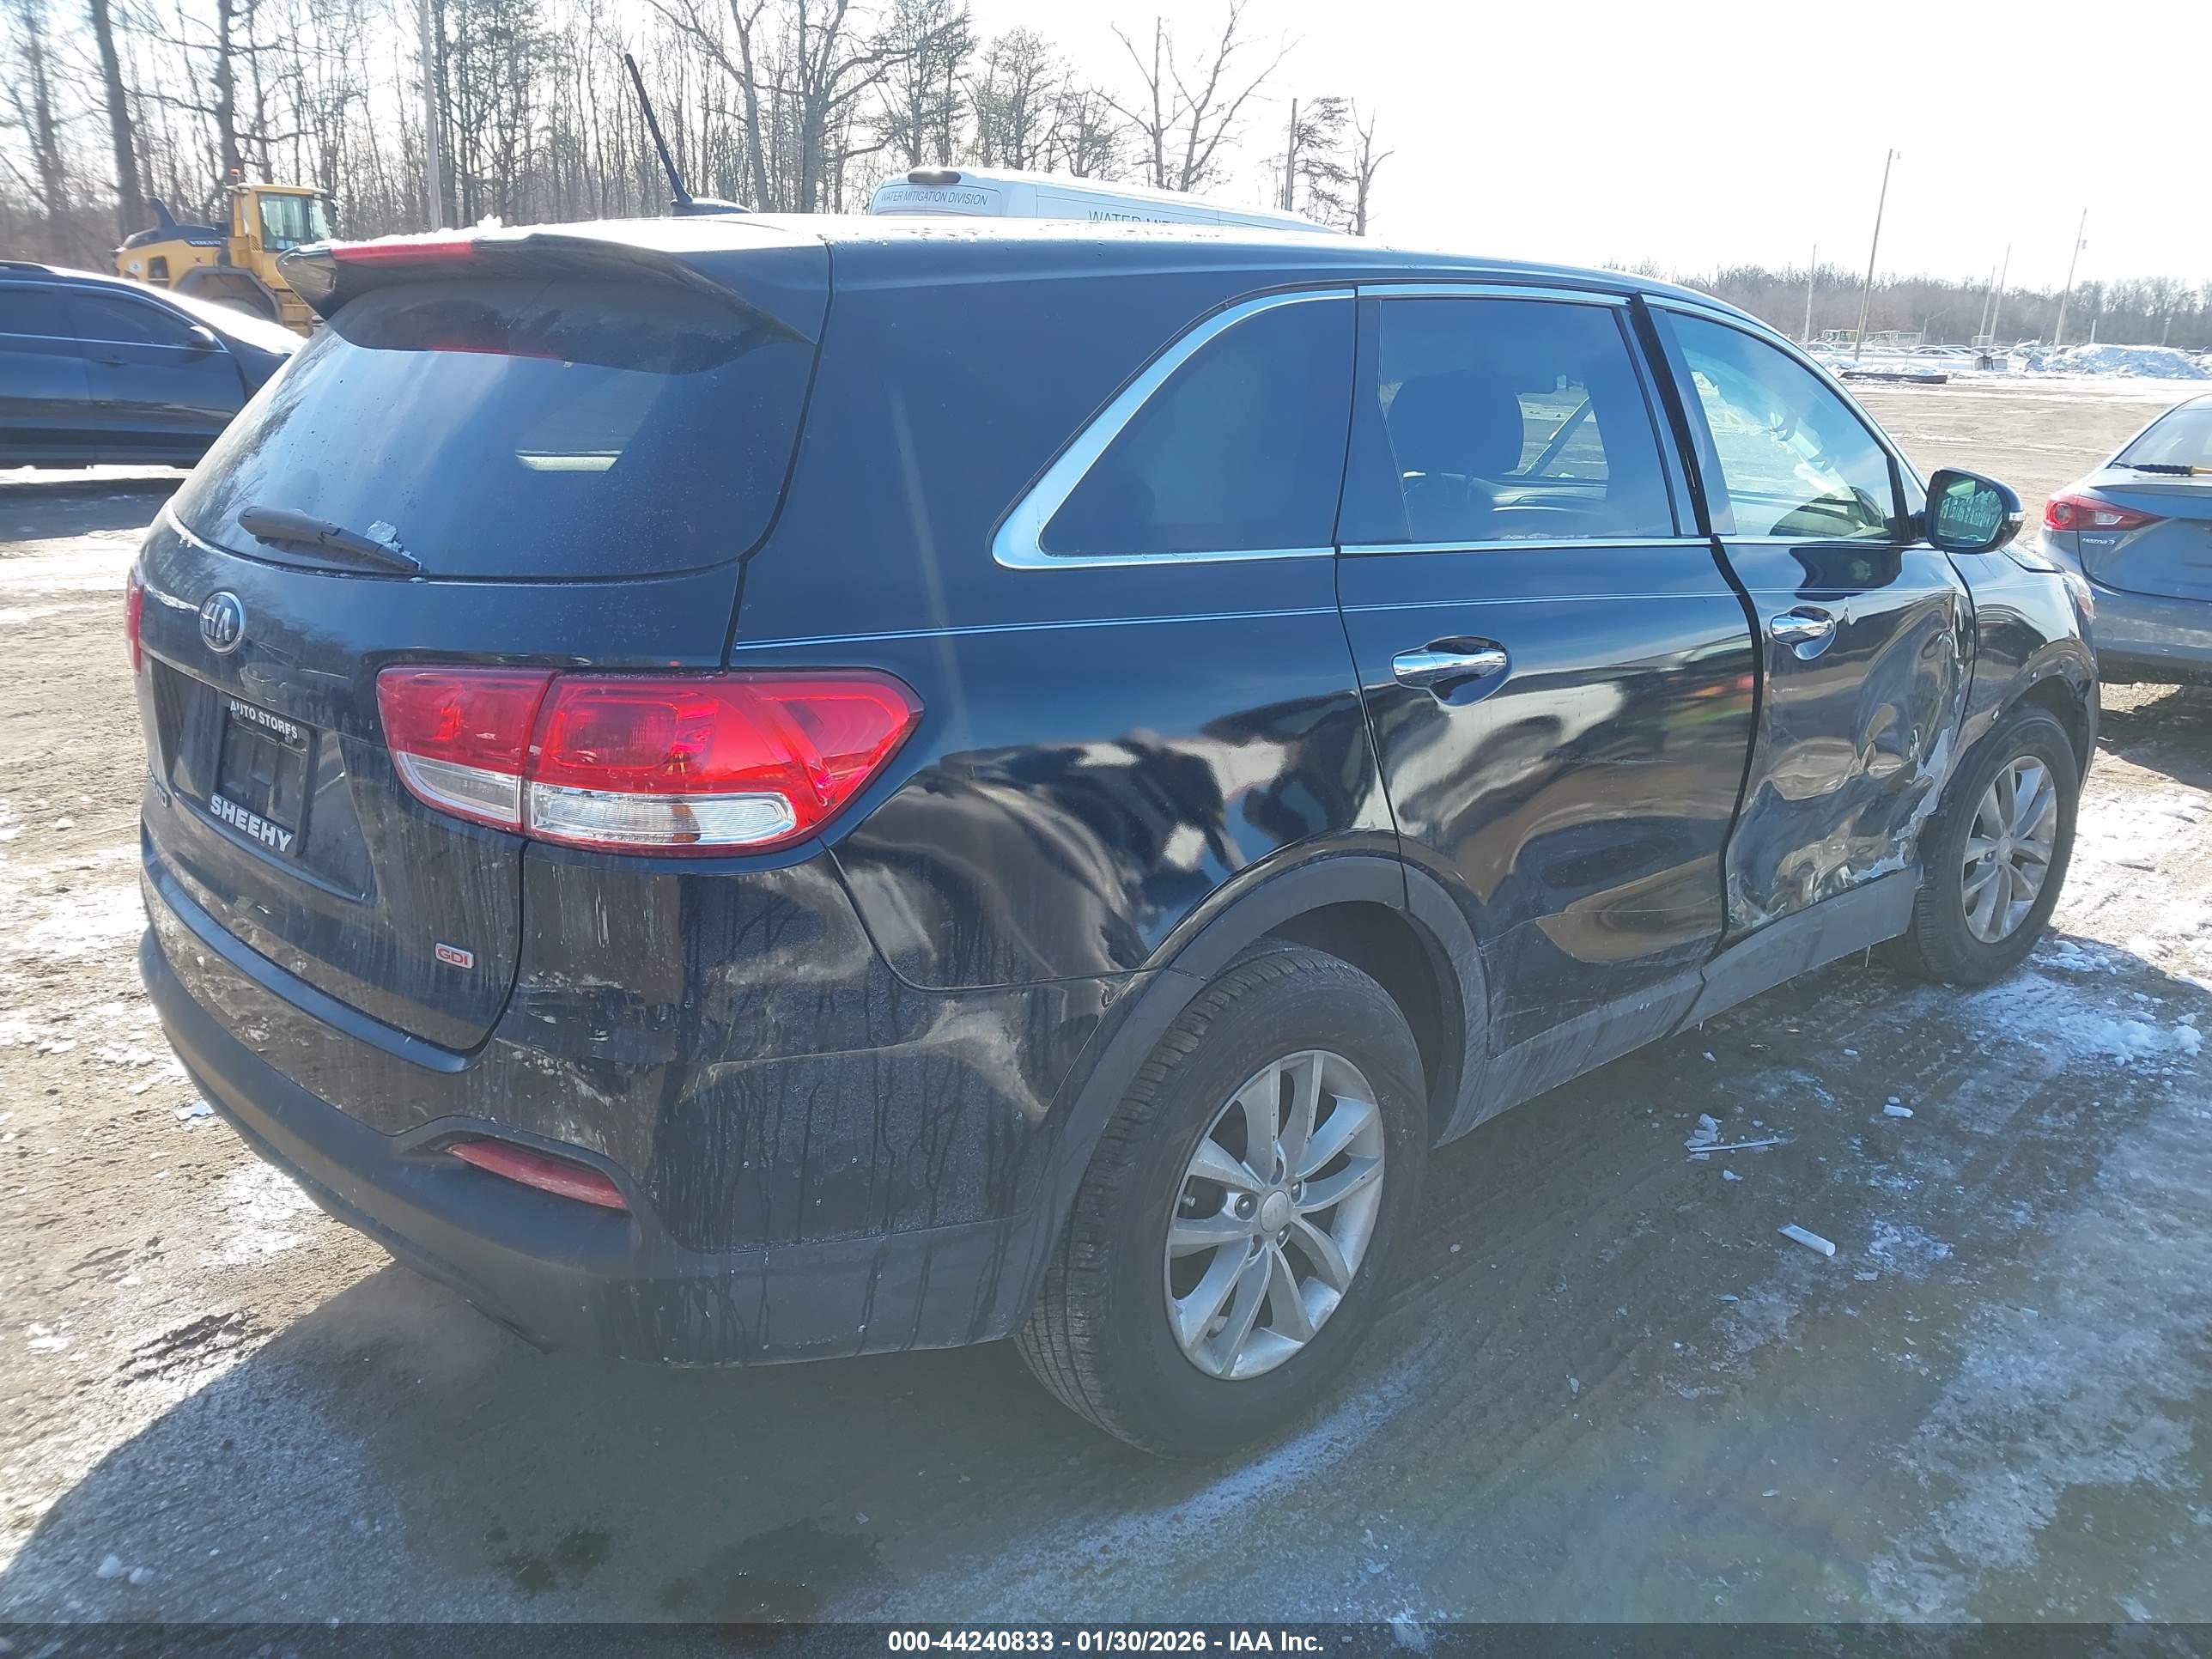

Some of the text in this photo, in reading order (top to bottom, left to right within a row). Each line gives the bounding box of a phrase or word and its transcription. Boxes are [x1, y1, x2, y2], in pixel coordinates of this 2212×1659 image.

[881, 191, 988, 205] WATER MITIGATION DIVISION
[200, 601, 232, 641] KIA
[230, 700, 298, 739] AUTO STORES
[210, 794, 292, 853] SHEEHY
[438, 948, 468, 965] GDI
